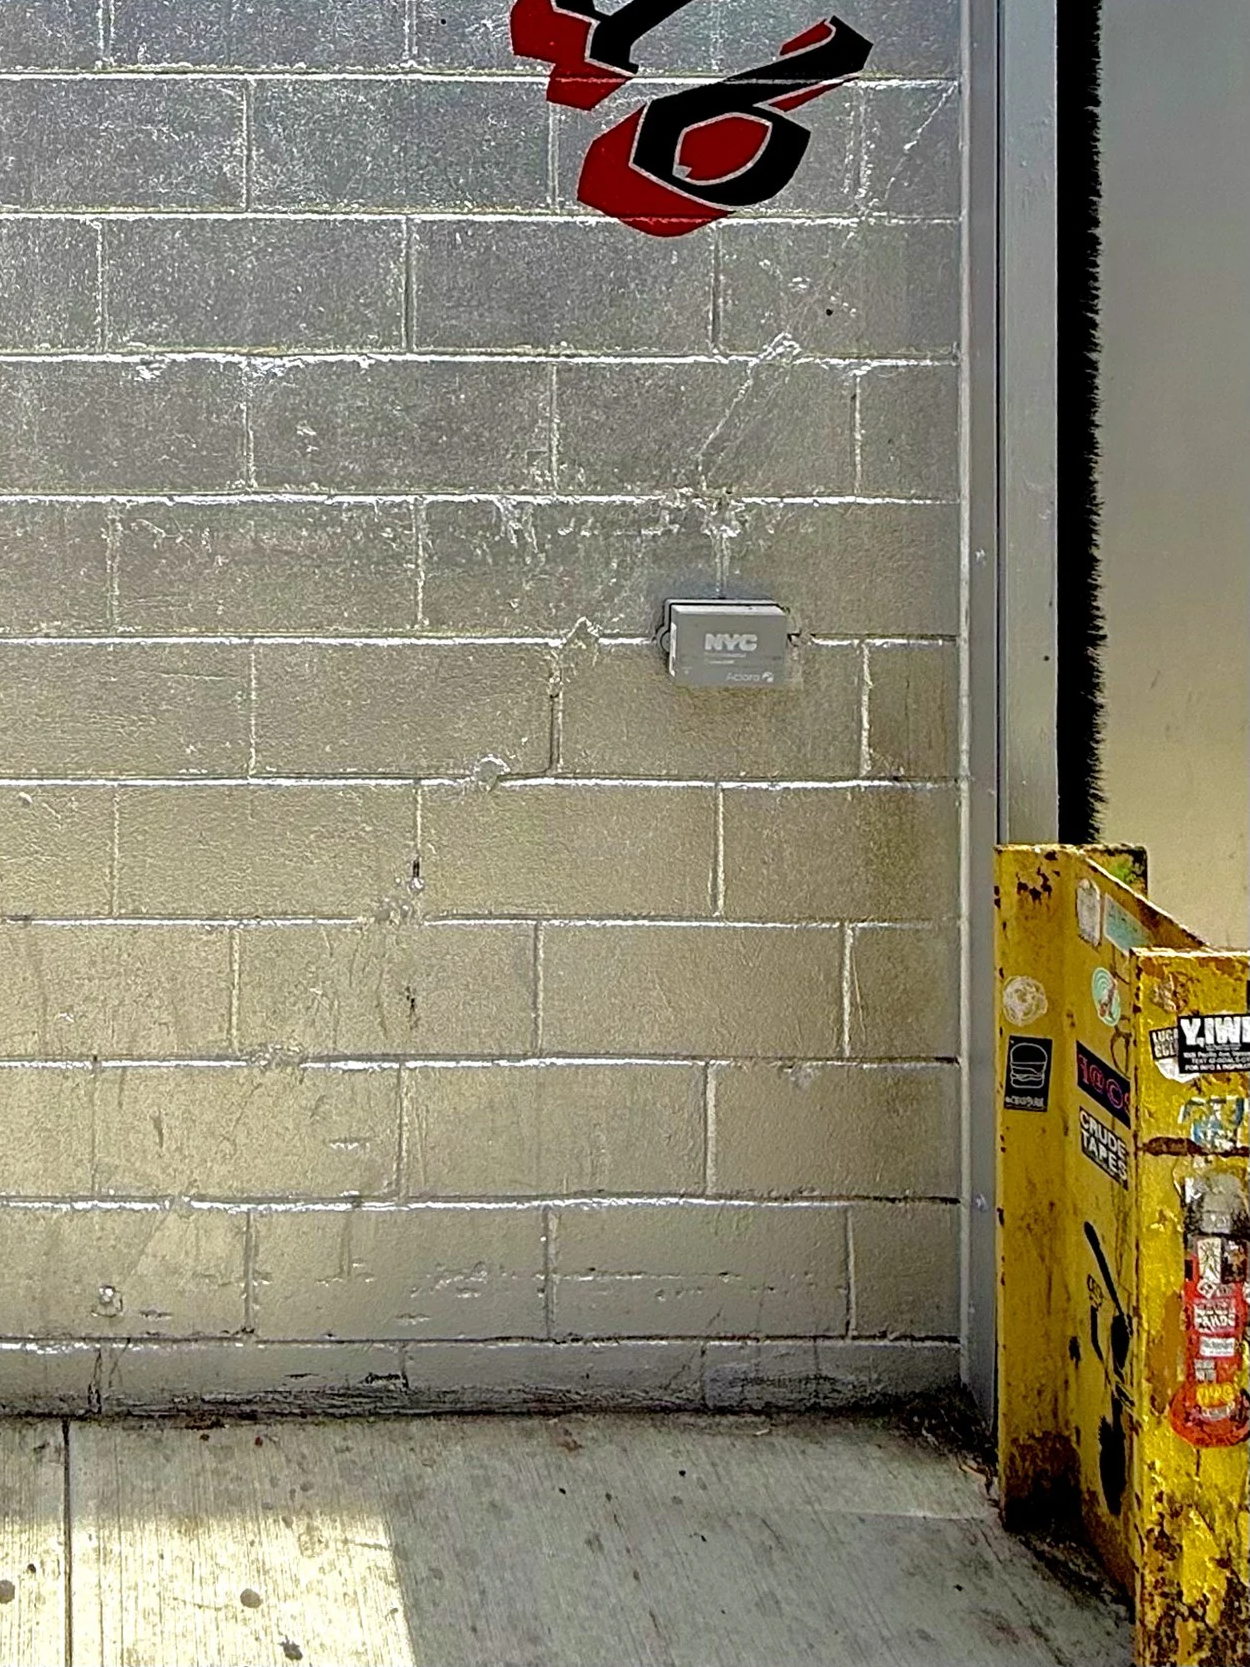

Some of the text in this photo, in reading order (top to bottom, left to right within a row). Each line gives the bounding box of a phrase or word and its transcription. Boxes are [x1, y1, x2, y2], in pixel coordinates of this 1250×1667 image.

[705, 633, 758, 651] NYC
[1080, 1109, 1127, 1160] CRUDE
[1081, 1128, 1128, 1181] TAPES
